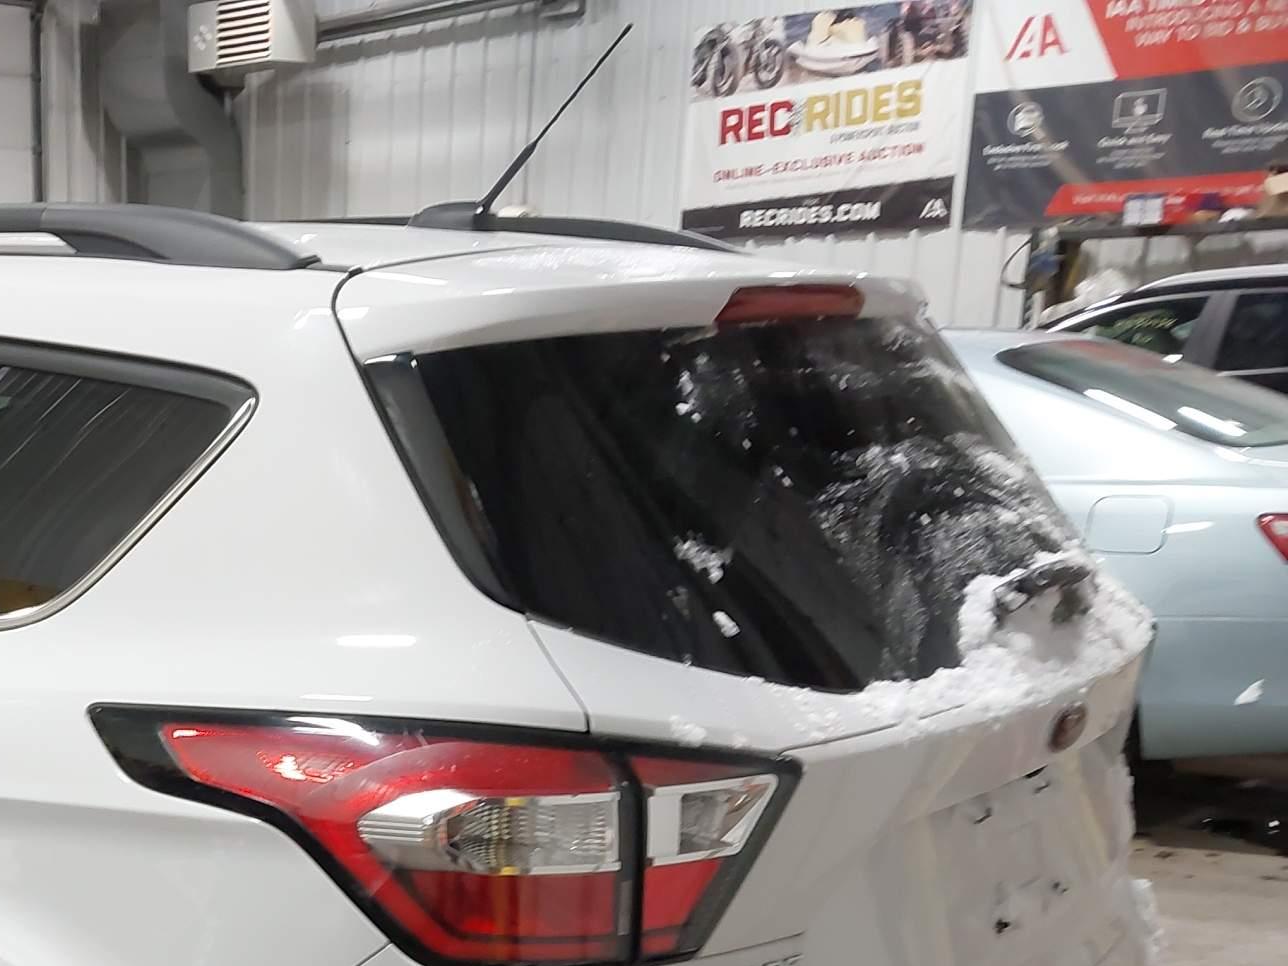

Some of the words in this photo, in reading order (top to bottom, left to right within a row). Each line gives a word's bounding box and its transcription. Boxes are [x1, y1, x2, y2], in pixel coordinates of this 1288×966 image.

[719, 99, 795, 146] REC
[805, 79, 924, 134] RIDES
[740, 201, 881, 228] RECRIDES.COM
